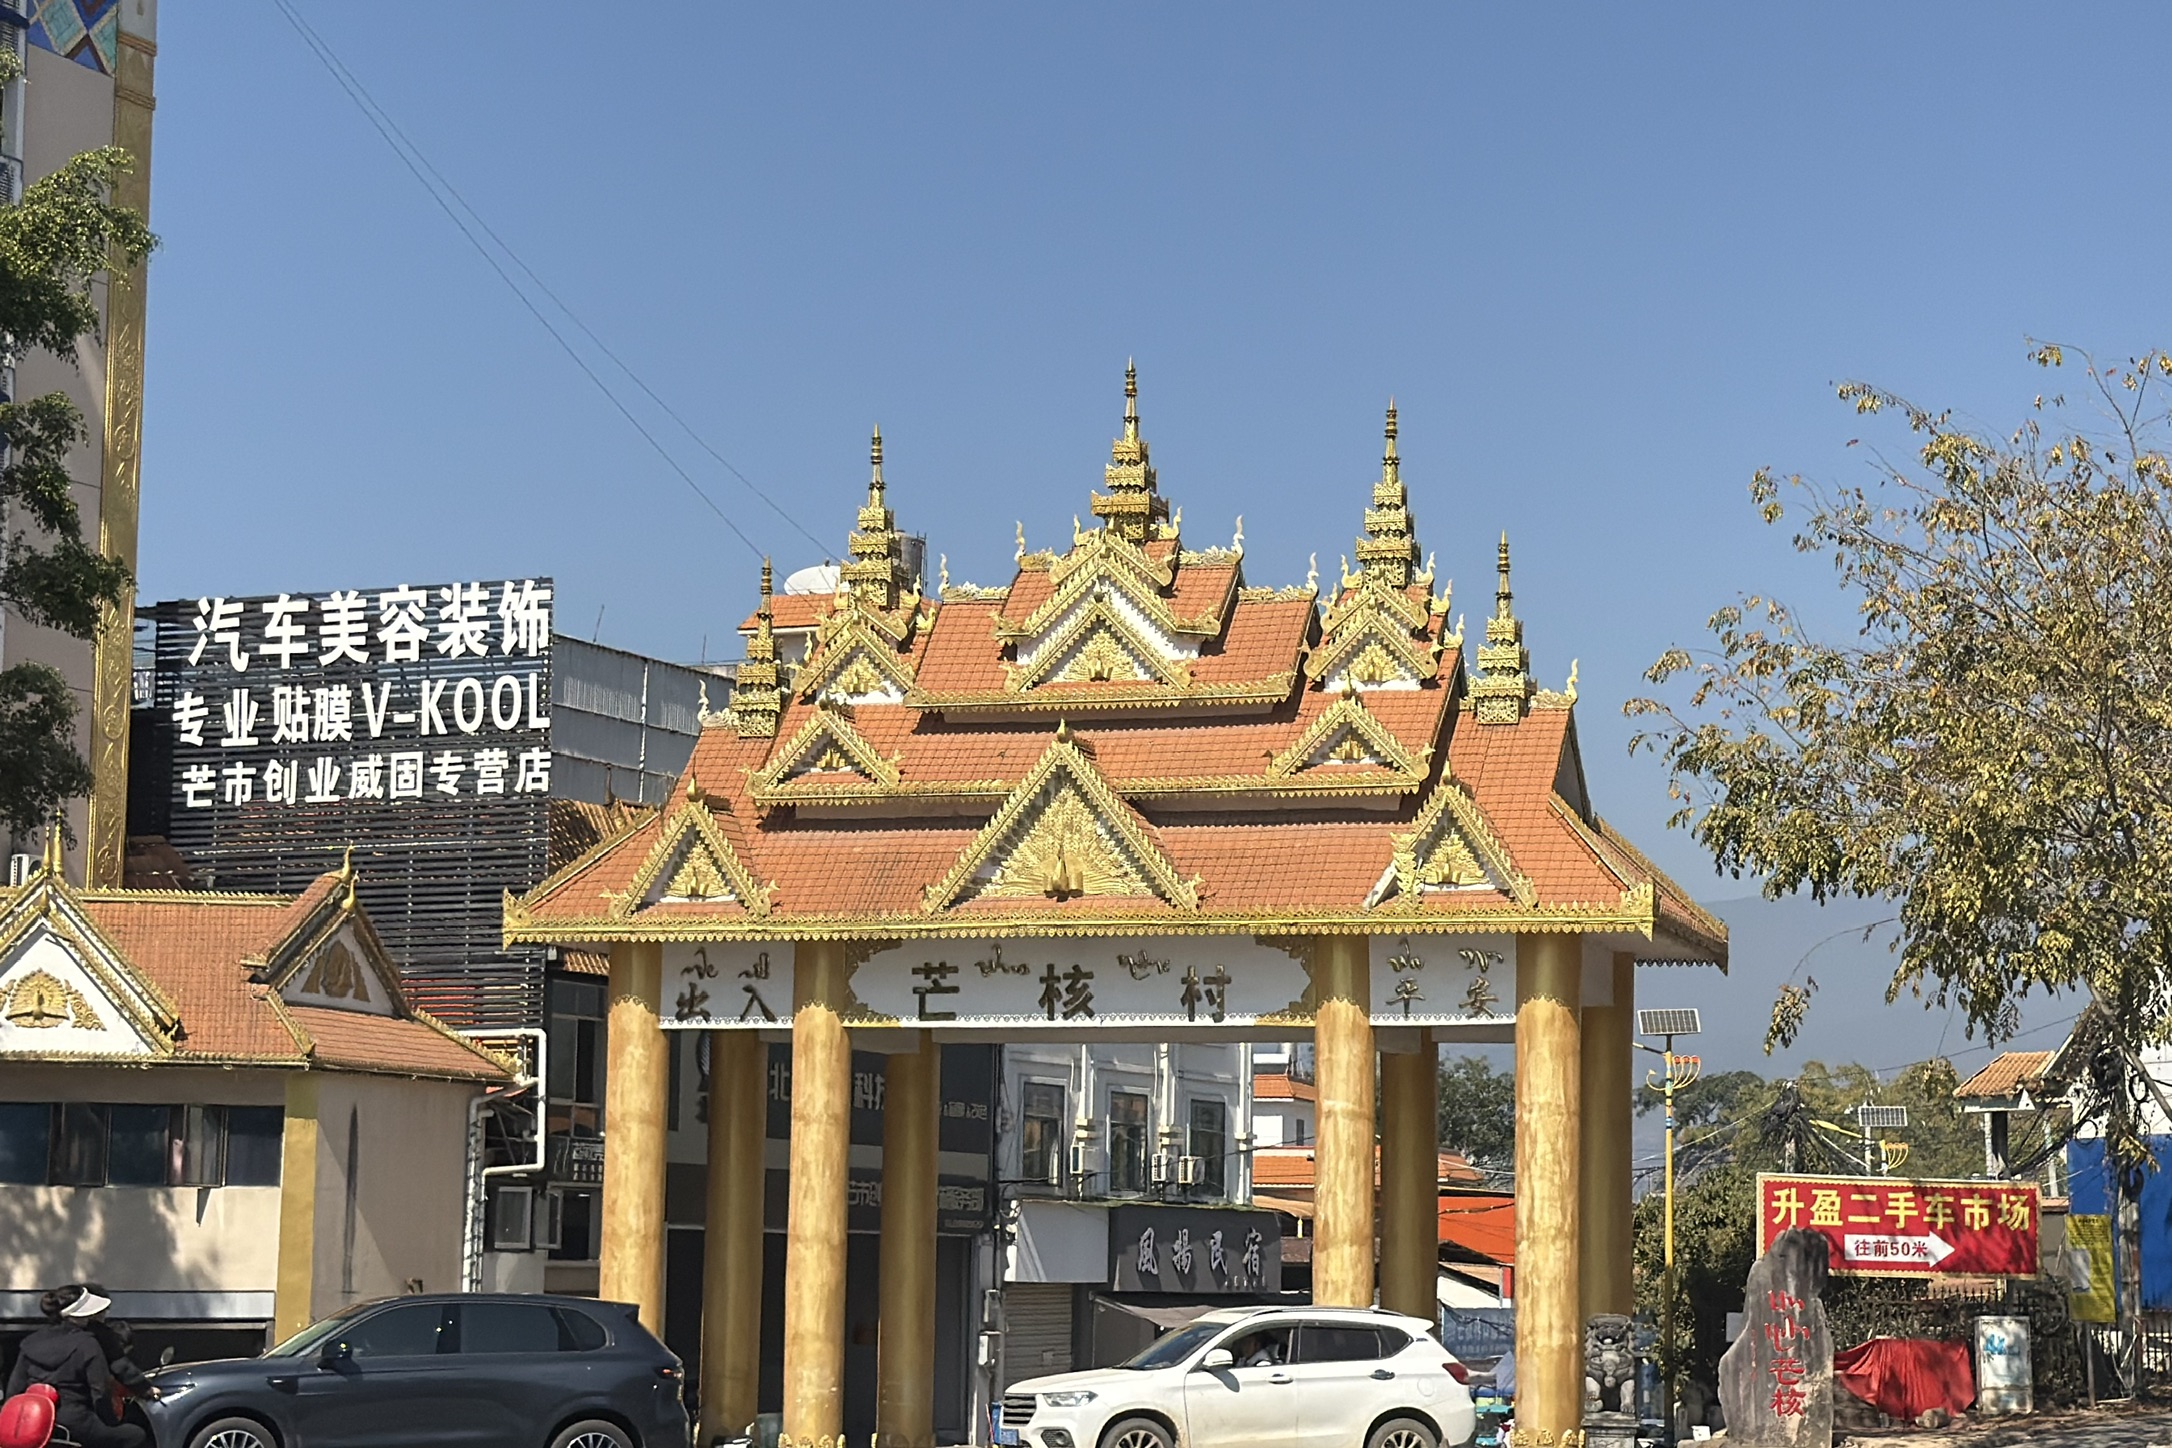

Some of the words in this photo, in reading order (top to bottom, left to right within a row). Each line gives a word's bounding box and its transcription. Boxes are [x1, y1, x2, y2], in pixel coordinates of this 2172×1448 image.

[188, 579, 552, 673] 汽车美容装饰
[182, 747, 551, 808] 芒市创业威固专营店
[912, 961, 1232, 1023] 芒核村
[1386, 975, 1499, 1019] 平安
[1771, 1187, 2030, 1231] 升盈二手车市场
[1854, 1239, 1928, 1257] 往前50米
